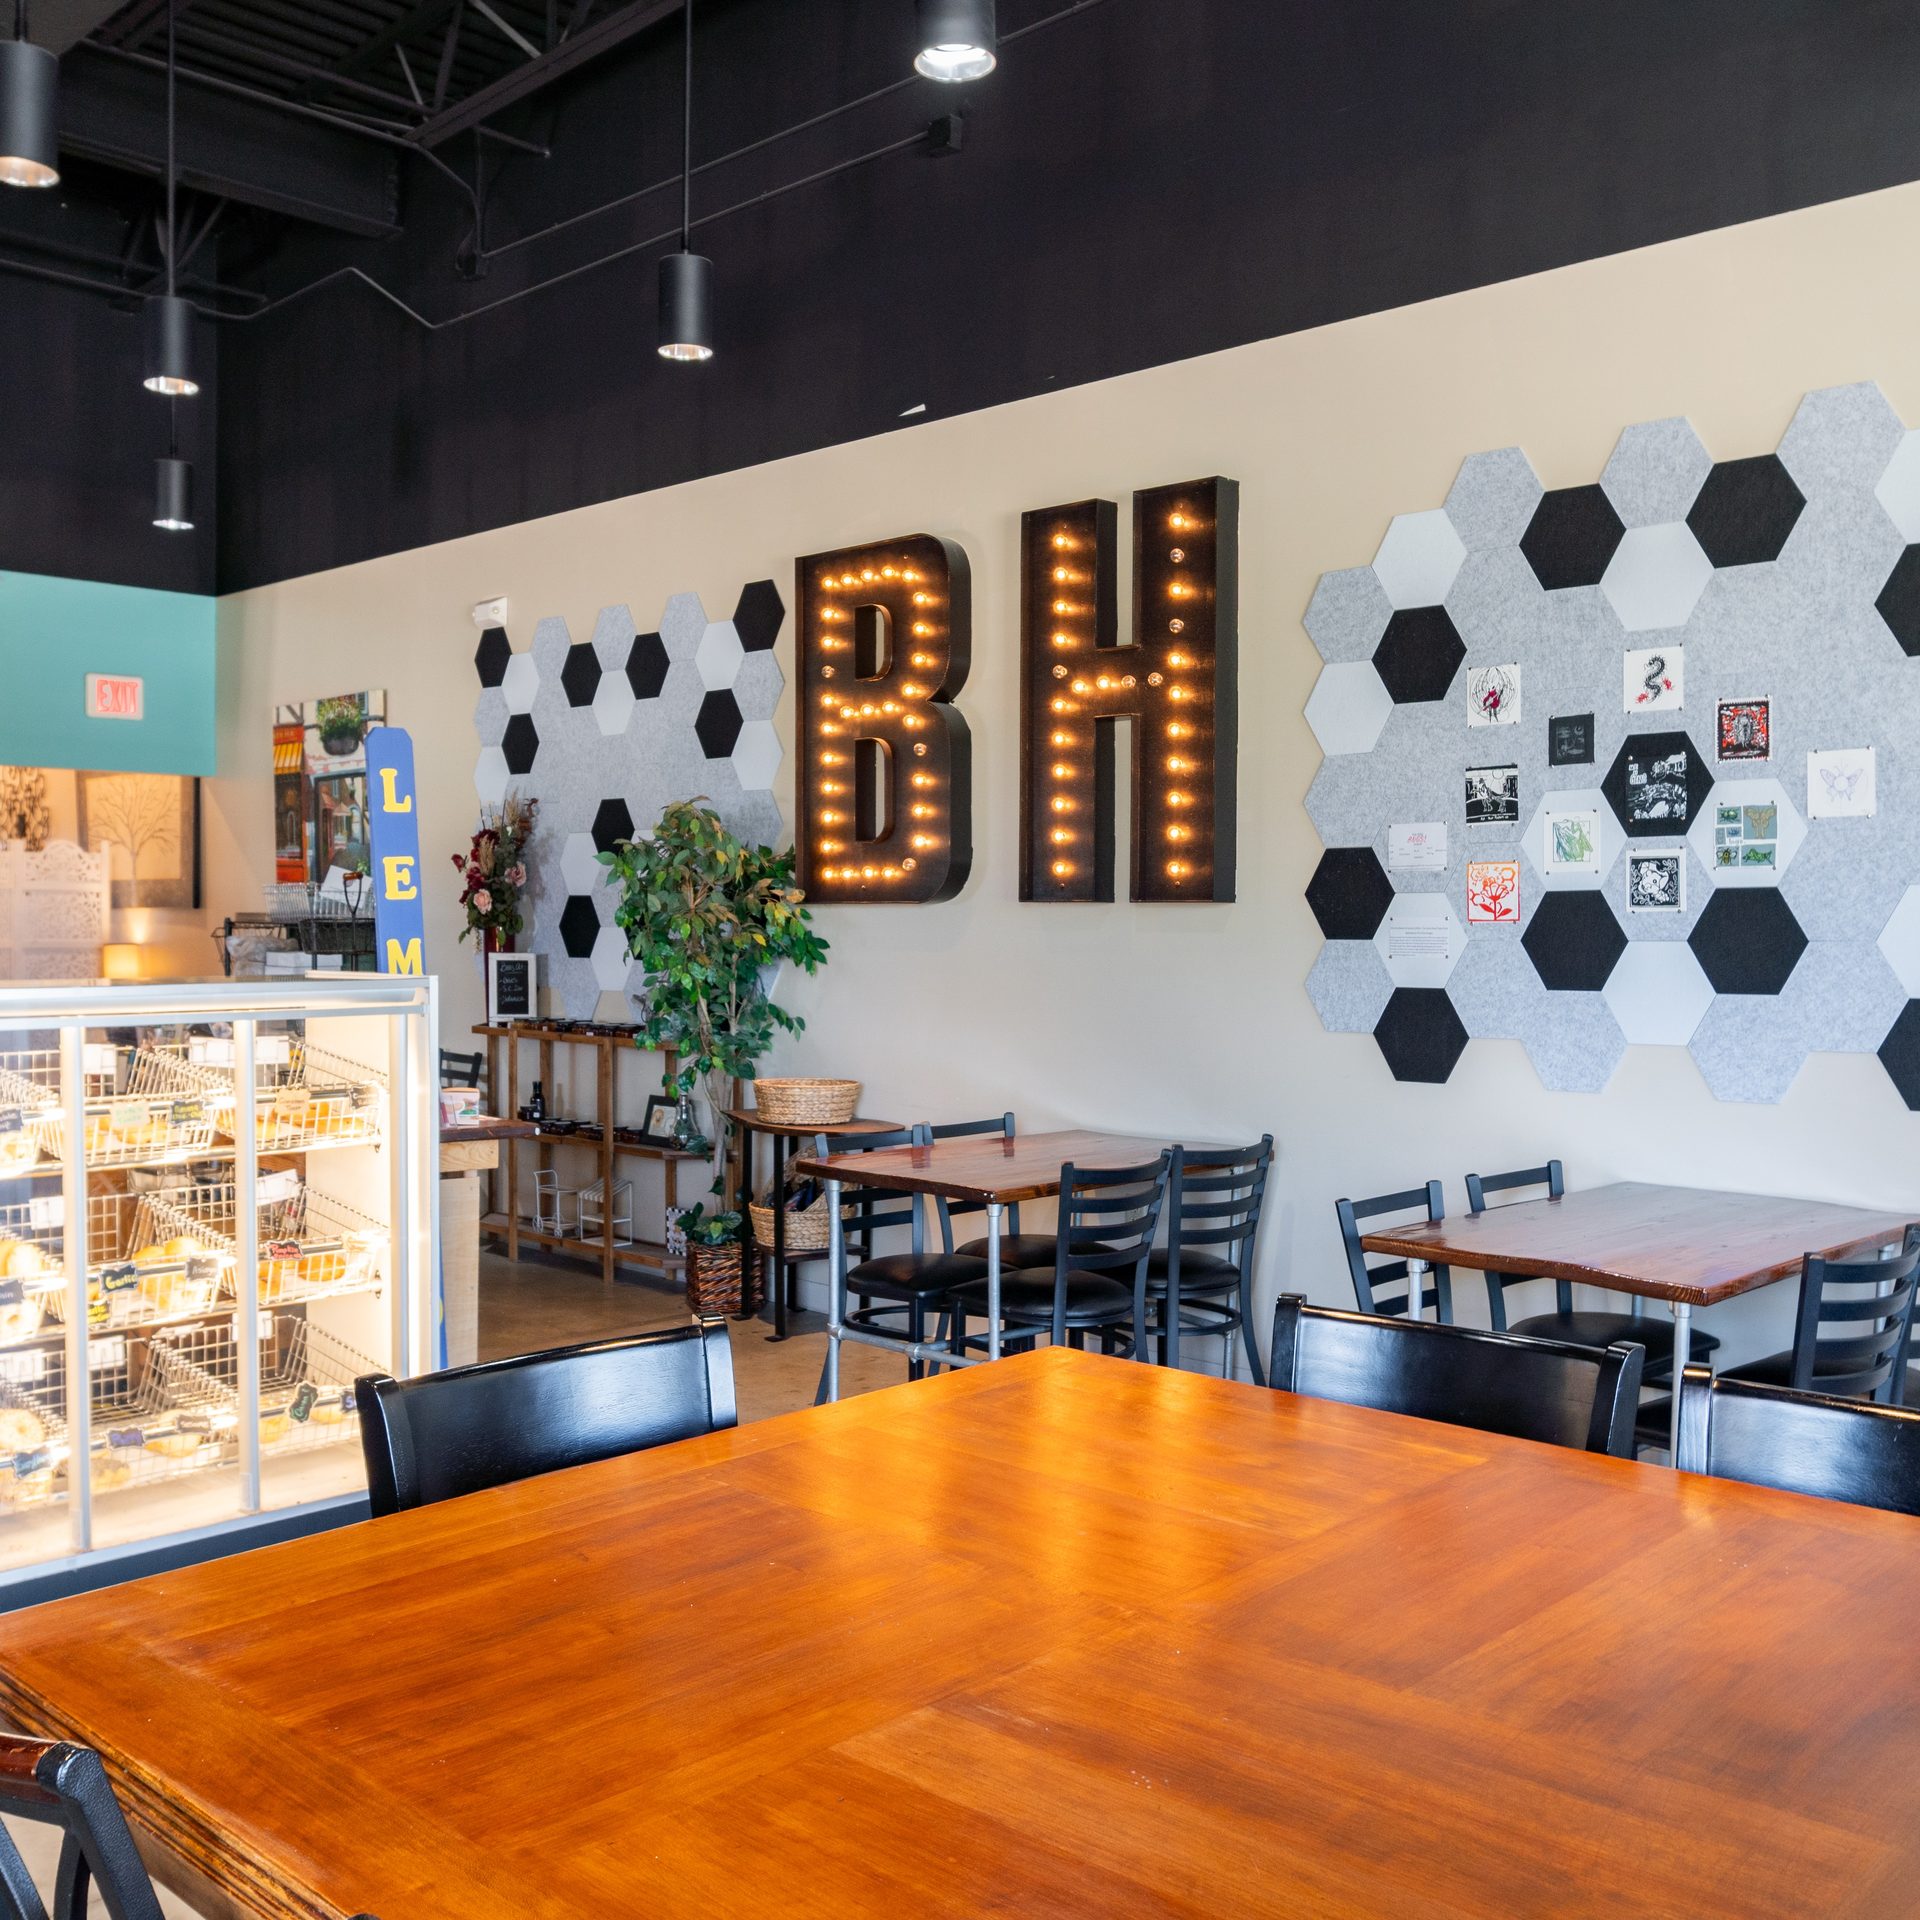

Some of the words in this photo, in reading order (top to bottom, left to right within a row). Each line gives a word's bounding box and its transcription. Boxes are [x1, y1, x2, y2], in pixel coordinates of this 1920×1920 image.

[96, 679, 138, 713] EXIT
[795, 476, 1239, 904] BH
[105, 1274, 137, 1290] Garlic
